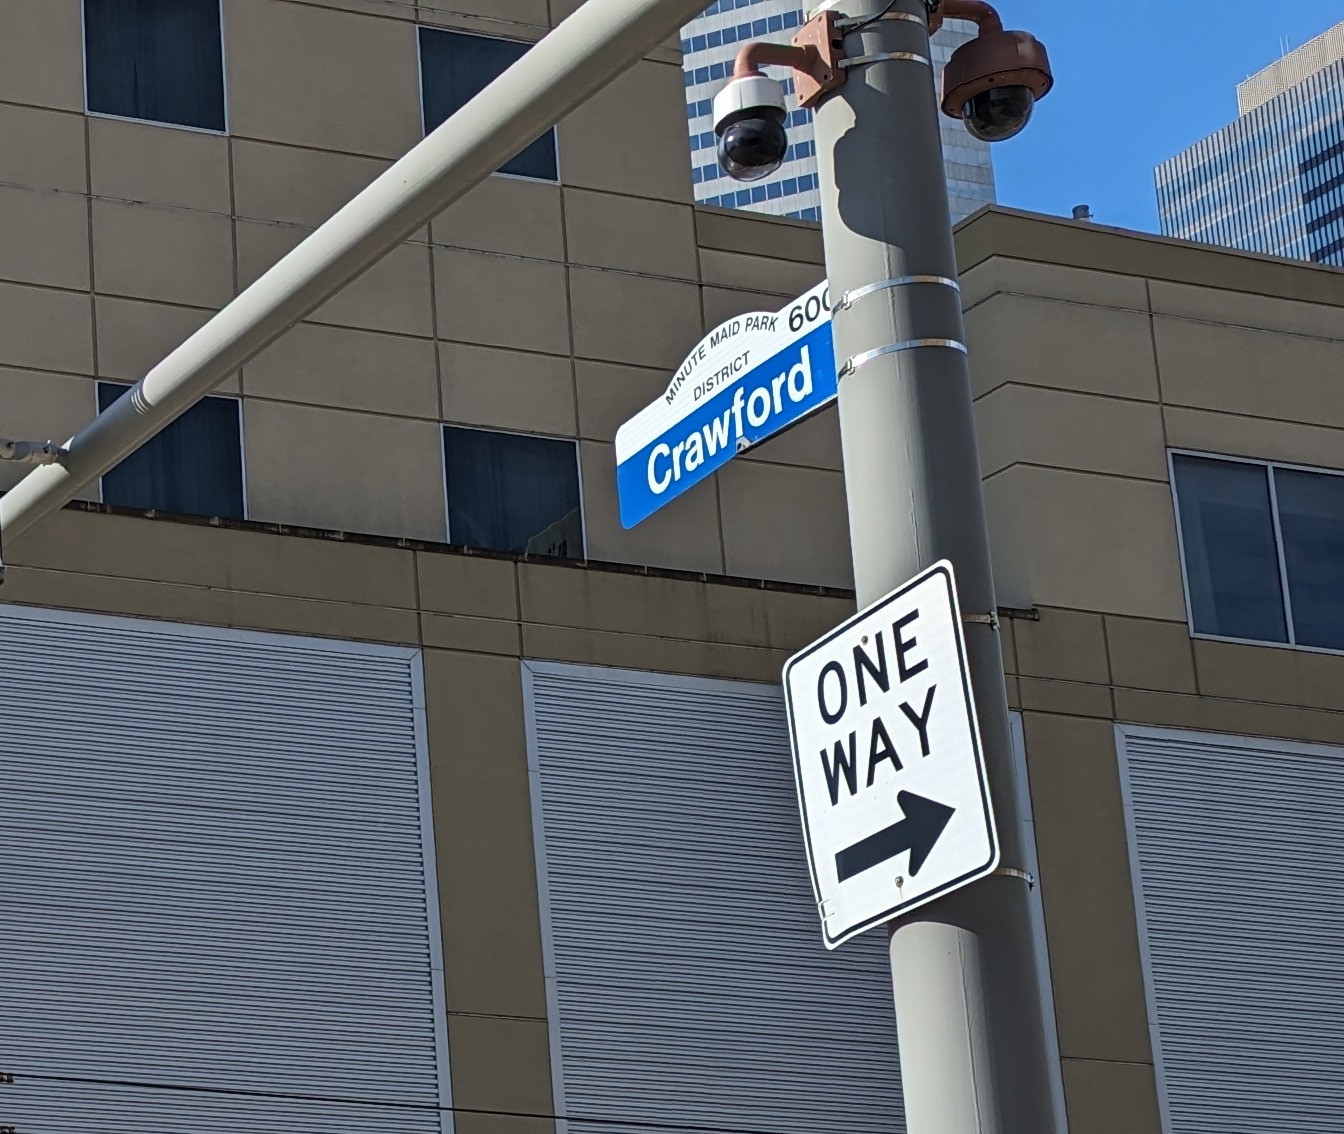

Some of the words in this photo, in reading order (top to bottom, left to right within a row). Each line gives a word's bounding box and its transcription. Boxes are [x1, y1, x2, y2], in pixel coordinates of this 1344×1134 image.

[665, 344, 707, 406] MINUTE
[710, 320, 741, 349] MAID
[744, 315, 779, 333] PARK
[693, 350, 751, 402] DISTRICT
[646, 344, 814, 495] Crawford
[817, 608, 929, 725] ONE
[819, 683, 937, 807] WAY
